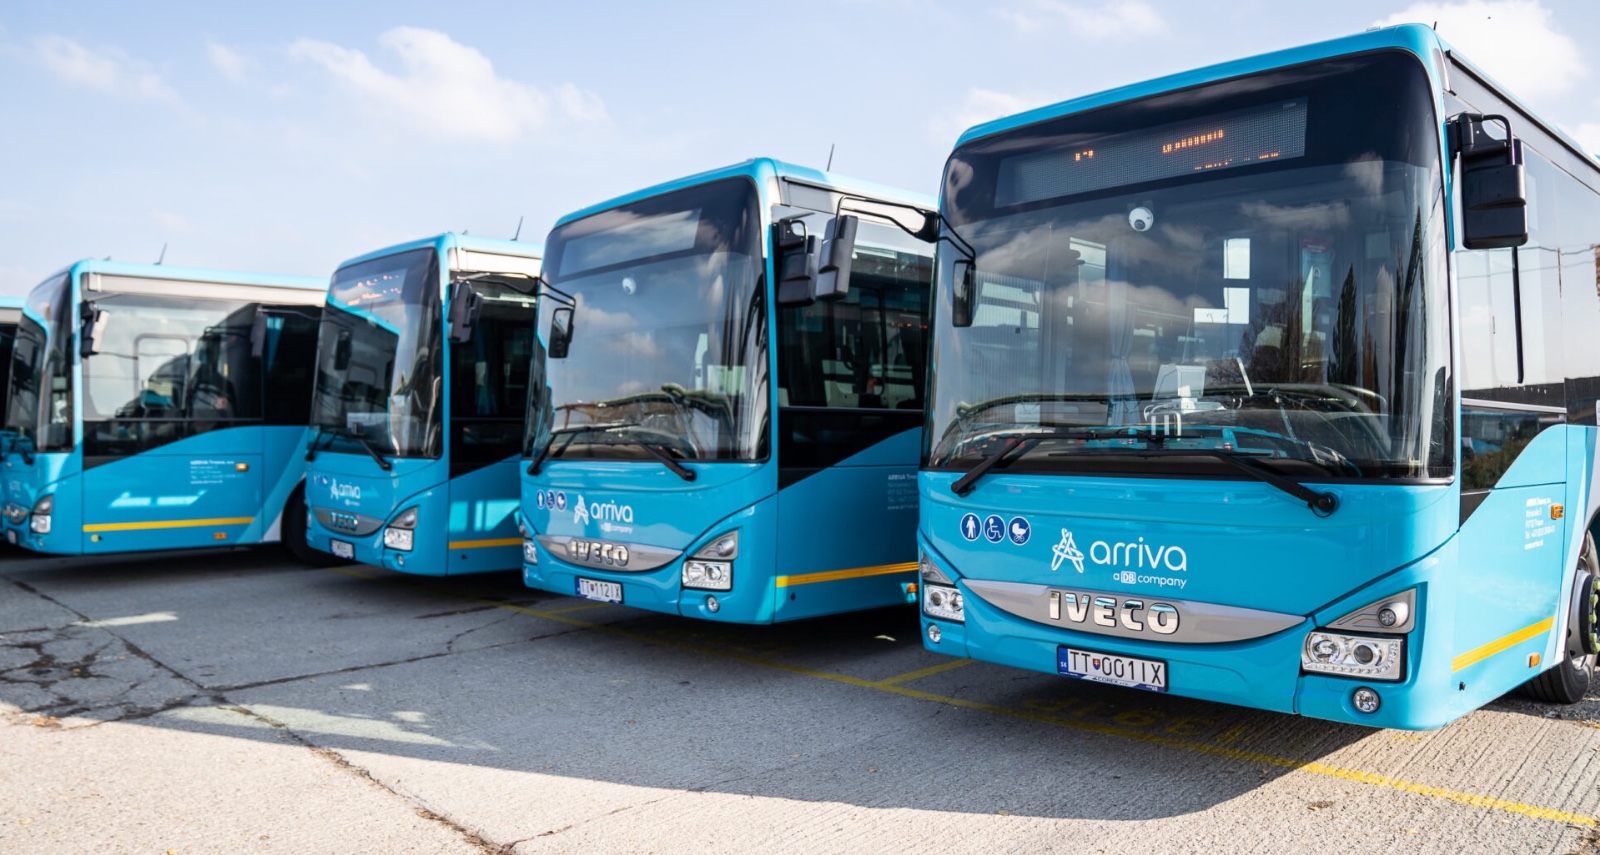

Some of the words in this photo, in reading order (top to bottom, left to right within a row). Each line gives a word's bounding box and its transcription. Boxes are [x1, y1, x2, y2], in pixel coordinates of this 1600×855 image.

[590, 499, 634, 523] arriva
[570, 539, 629, 567] IVECO
[1089, 536, 1187, 572] arriva
[1112, 572, 1120, 582] a
[1121, 571, 1136, 584] DB
[1137, 575, 1187, 590] company
[1048, 590, 1180, 635] IVECO
[1069, 651, 1091, 673] TT
